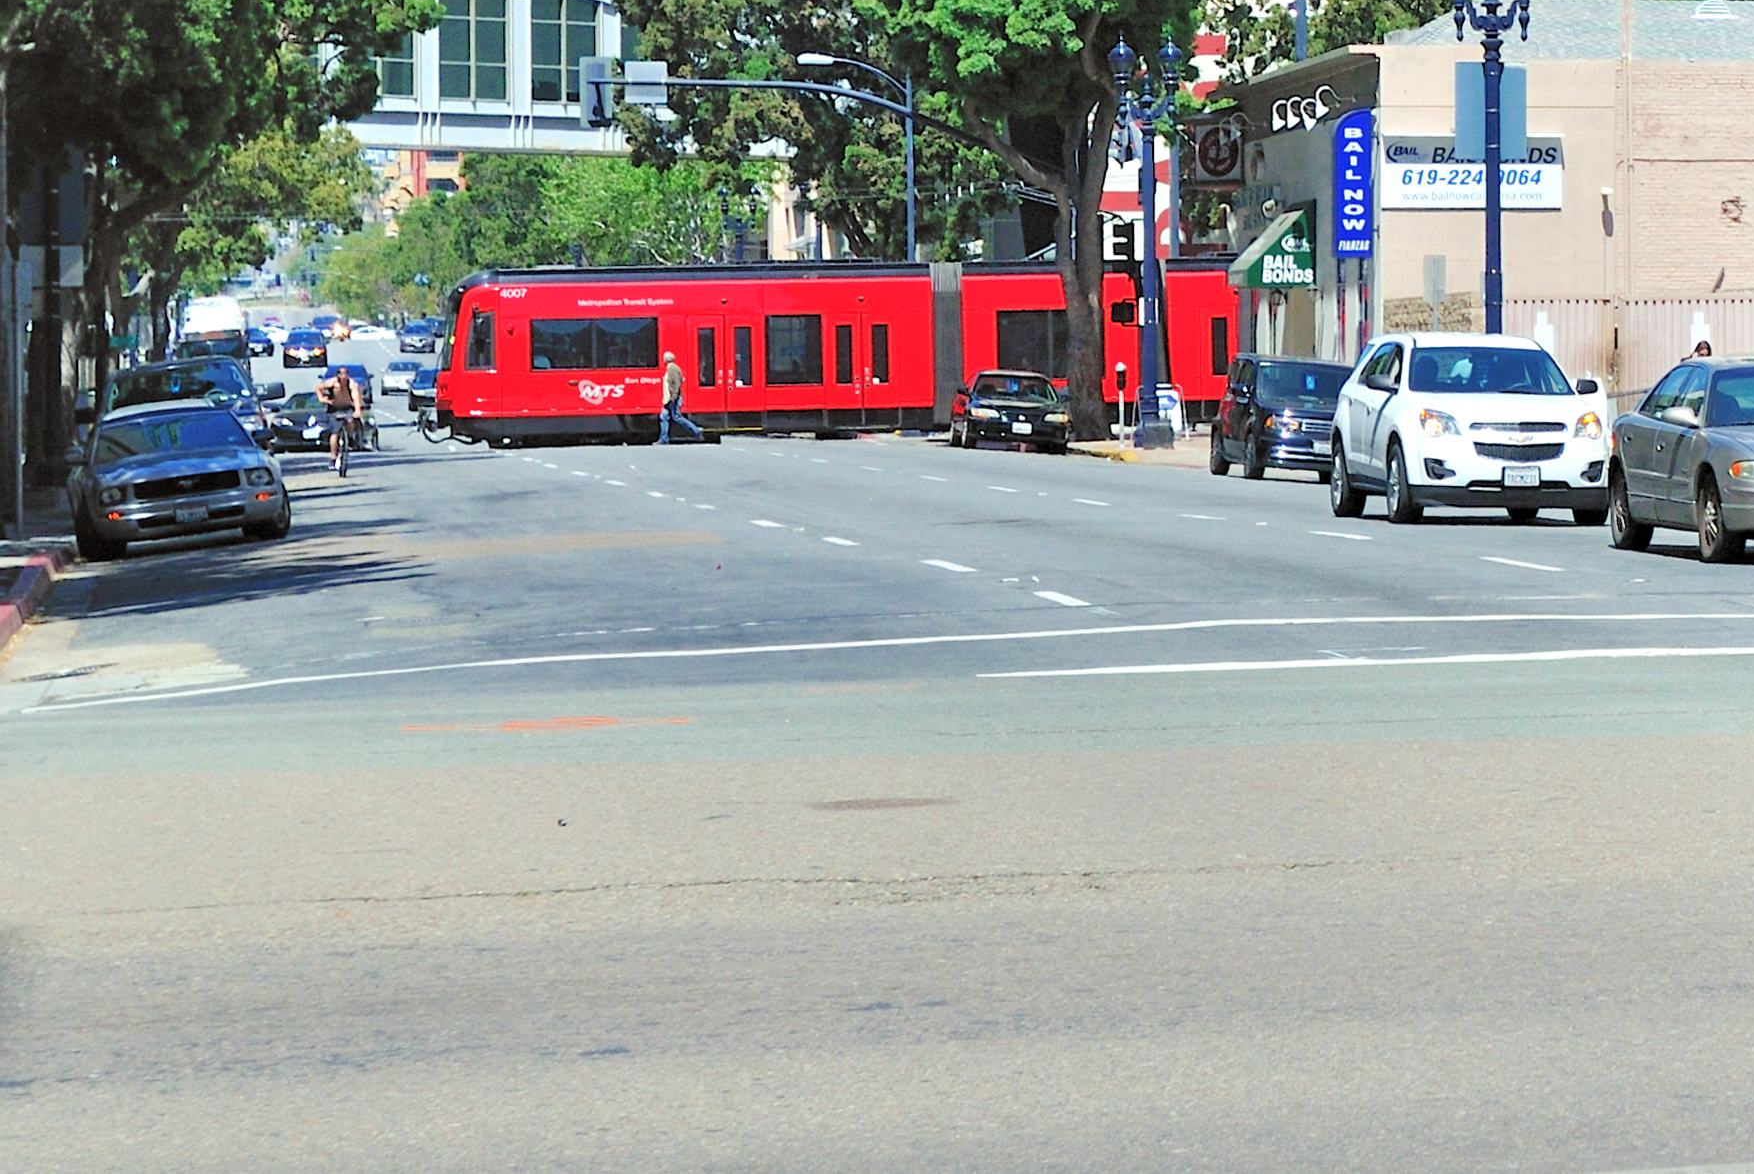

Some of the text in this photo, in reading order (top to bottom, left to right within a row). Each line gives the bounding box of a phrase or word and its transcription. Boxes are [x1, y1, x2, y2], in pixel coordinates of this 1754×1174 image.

[1393, 146, 1419, 156] BAIL
[1342, 127, 1366, 231] BAIL NOW
[1263, 255, 1298, 269] BAIL
[1262, 269, 1314, 283] BONDS
[500, 288, 527, 298] 4007
[578, 298, 674, 308] Metropolitan Transit System
[580, 385, 625, 398] MTS
